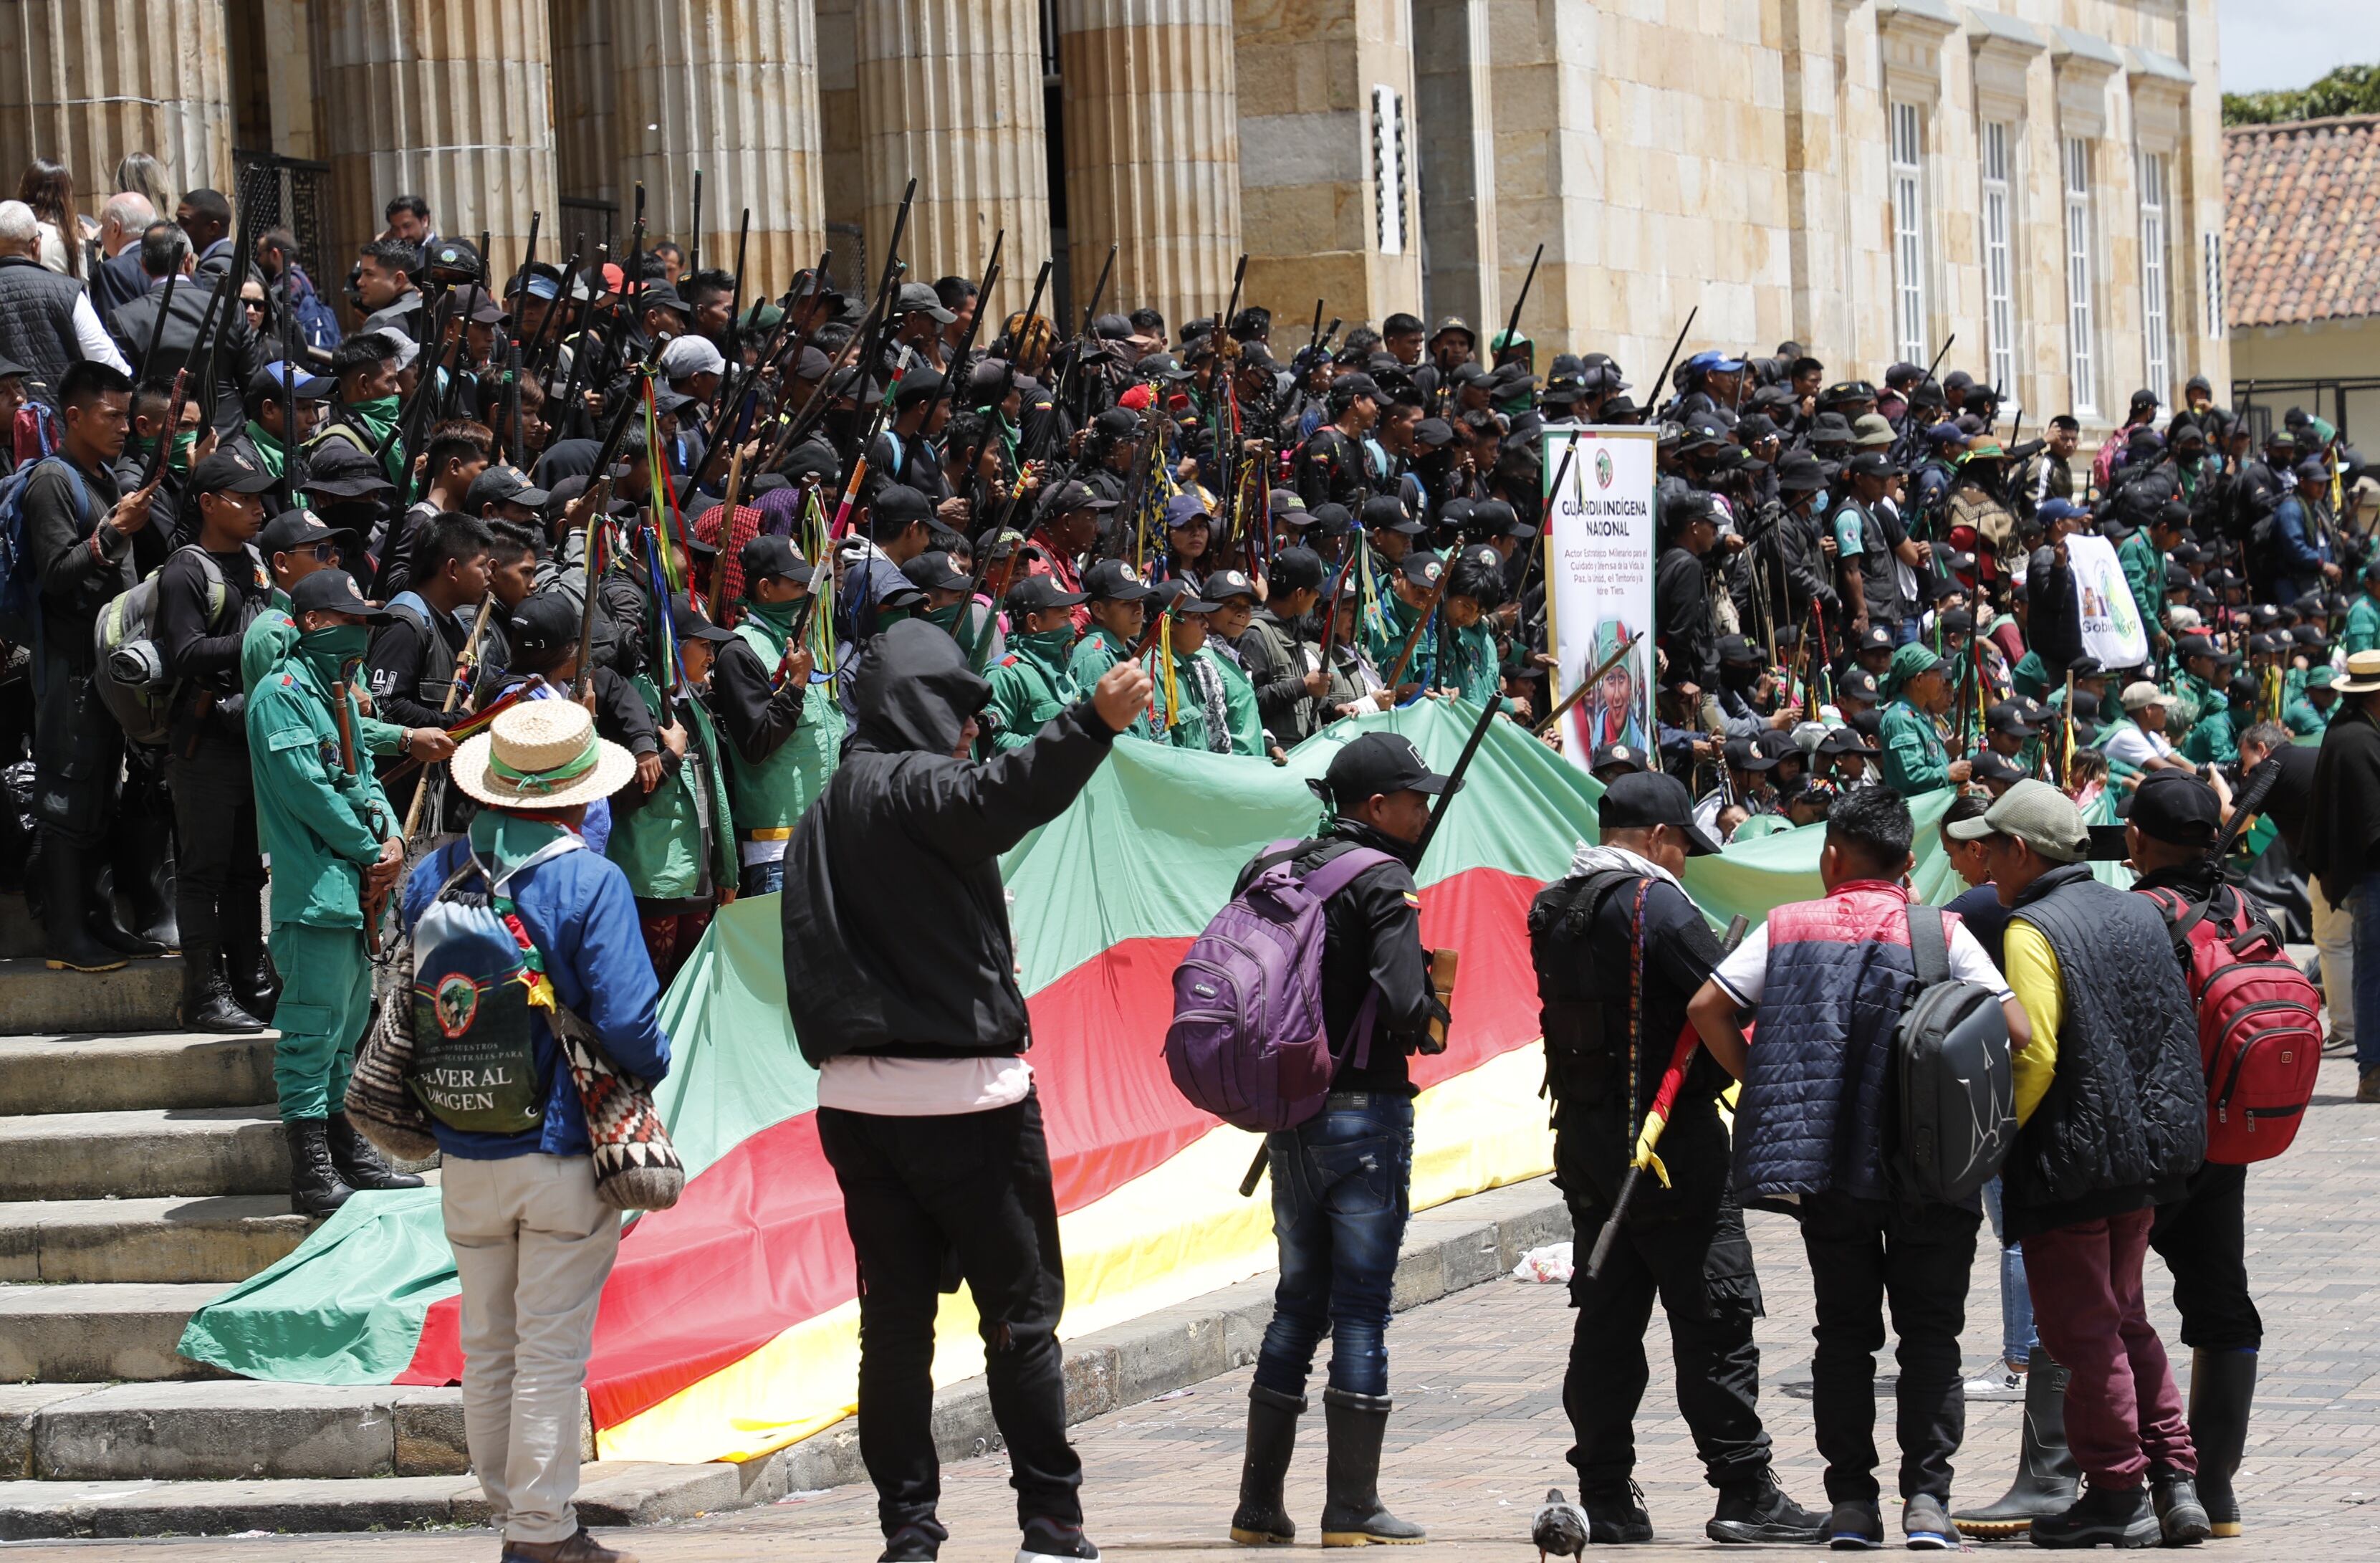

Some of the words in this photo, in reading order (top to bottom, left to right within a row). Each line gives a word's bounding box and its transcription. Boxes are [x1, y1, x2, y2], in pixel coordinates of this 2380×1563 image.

[1562, 500, 1602, 516] GUARDIA
[1603, 497, 1647, 516] INDÍGENA
[1586, 521, 1629, 537] NACIONAL
[1564, 549, 1583, 558] Actor
[1570, 561, 1594, 571] Cuidado
[1608, 573, 1615, 583] el
[479, 1066, 513, 1087] AL
